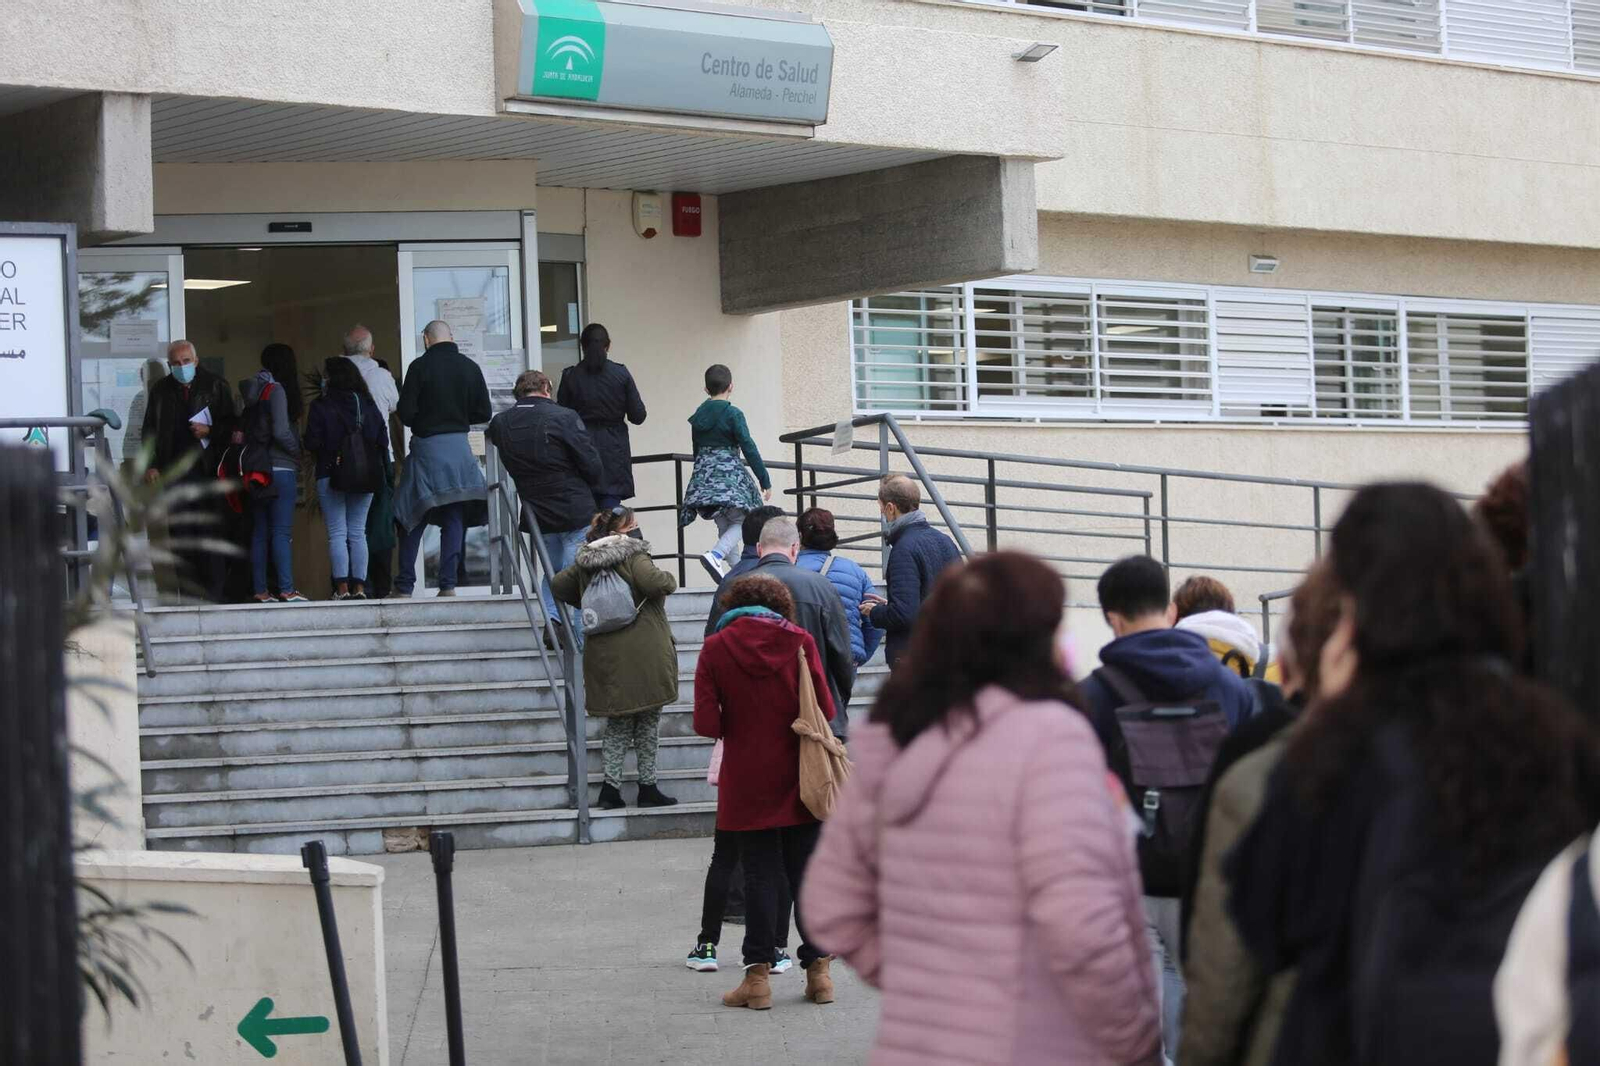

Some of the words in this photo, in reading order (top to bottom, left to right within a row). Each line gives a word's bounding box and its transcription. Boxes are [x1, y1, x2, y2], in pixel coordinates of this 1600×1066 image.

[701, 52, 750, 78] Centro
[755, 58, 773, 80] de
[778, 59, 819, 84] Salud
[730, 83, 772, 101] Alameda
[782, 87, 817, 105] Perchel
